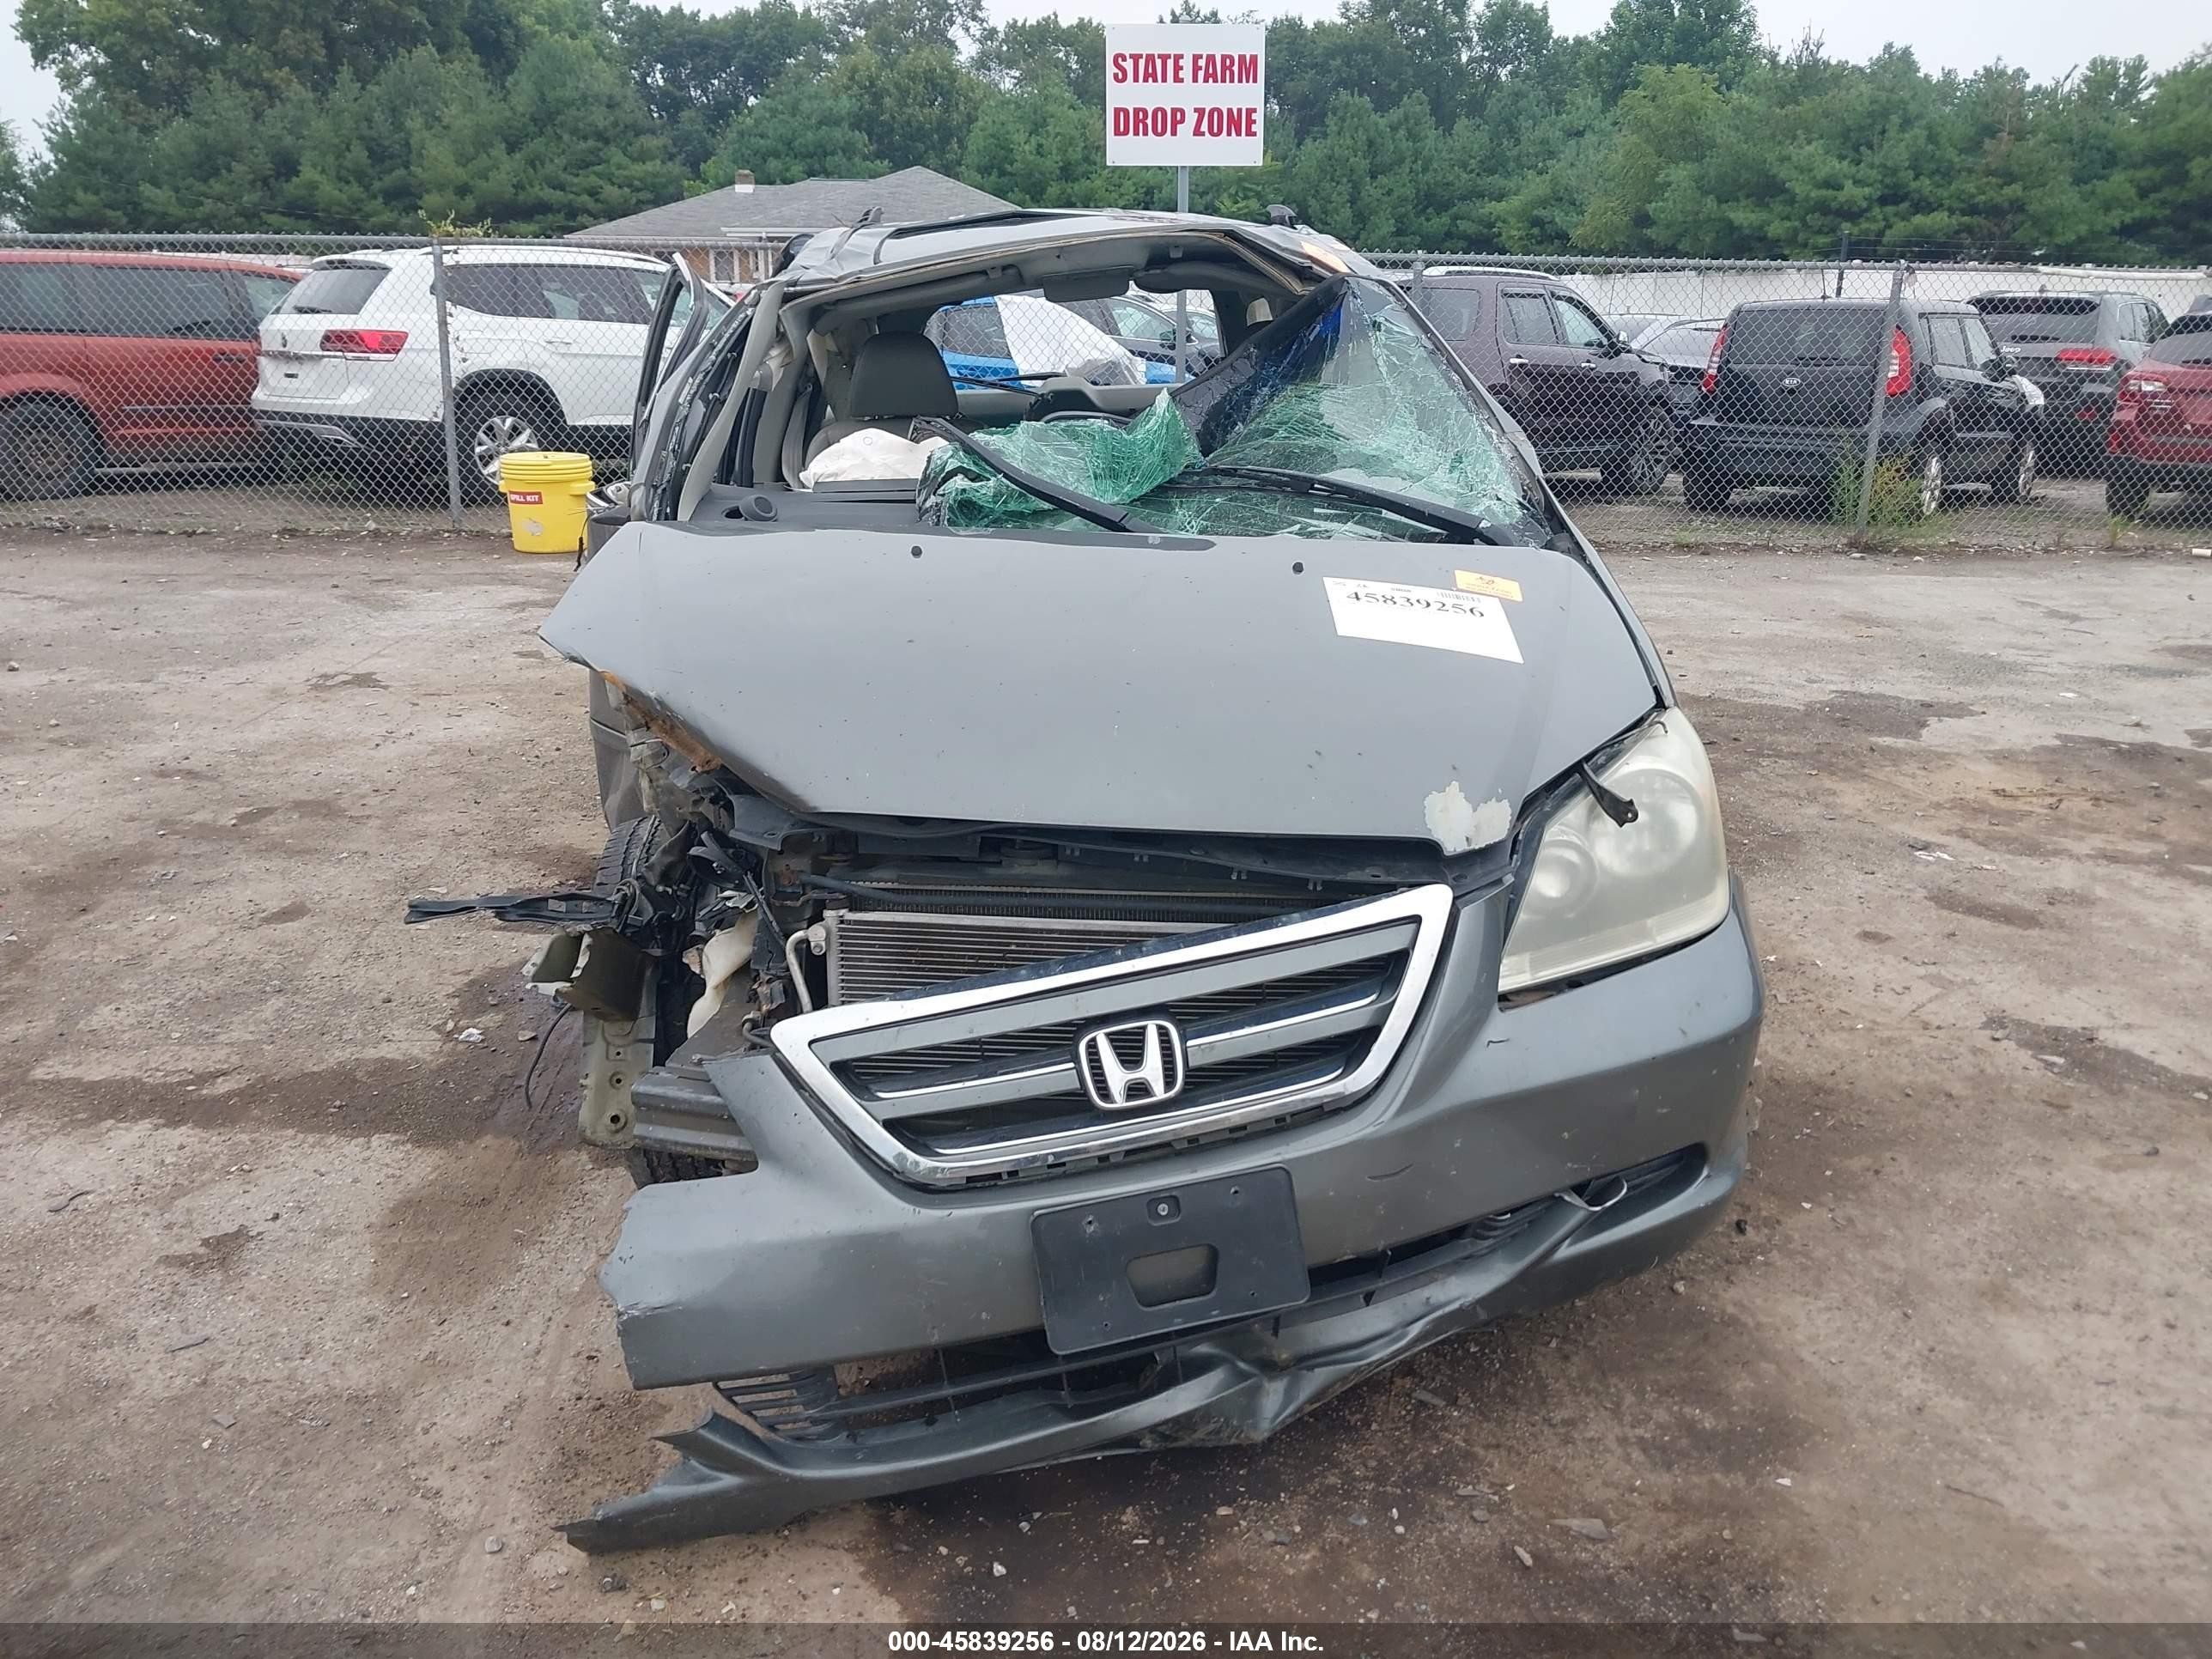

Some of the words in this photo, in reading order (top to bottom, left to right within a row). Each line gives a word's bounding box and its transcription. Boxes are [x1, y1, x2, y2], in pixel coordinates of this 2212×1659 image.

[1113, 52, 1184, 83] STATE
[1192, 53, 1258, 83] FARM
[1114, 106, 1185, 137] DROP
[1192, 107, 1257, 137] ZONE
[1346, 591, 1485, 617] 45839256
